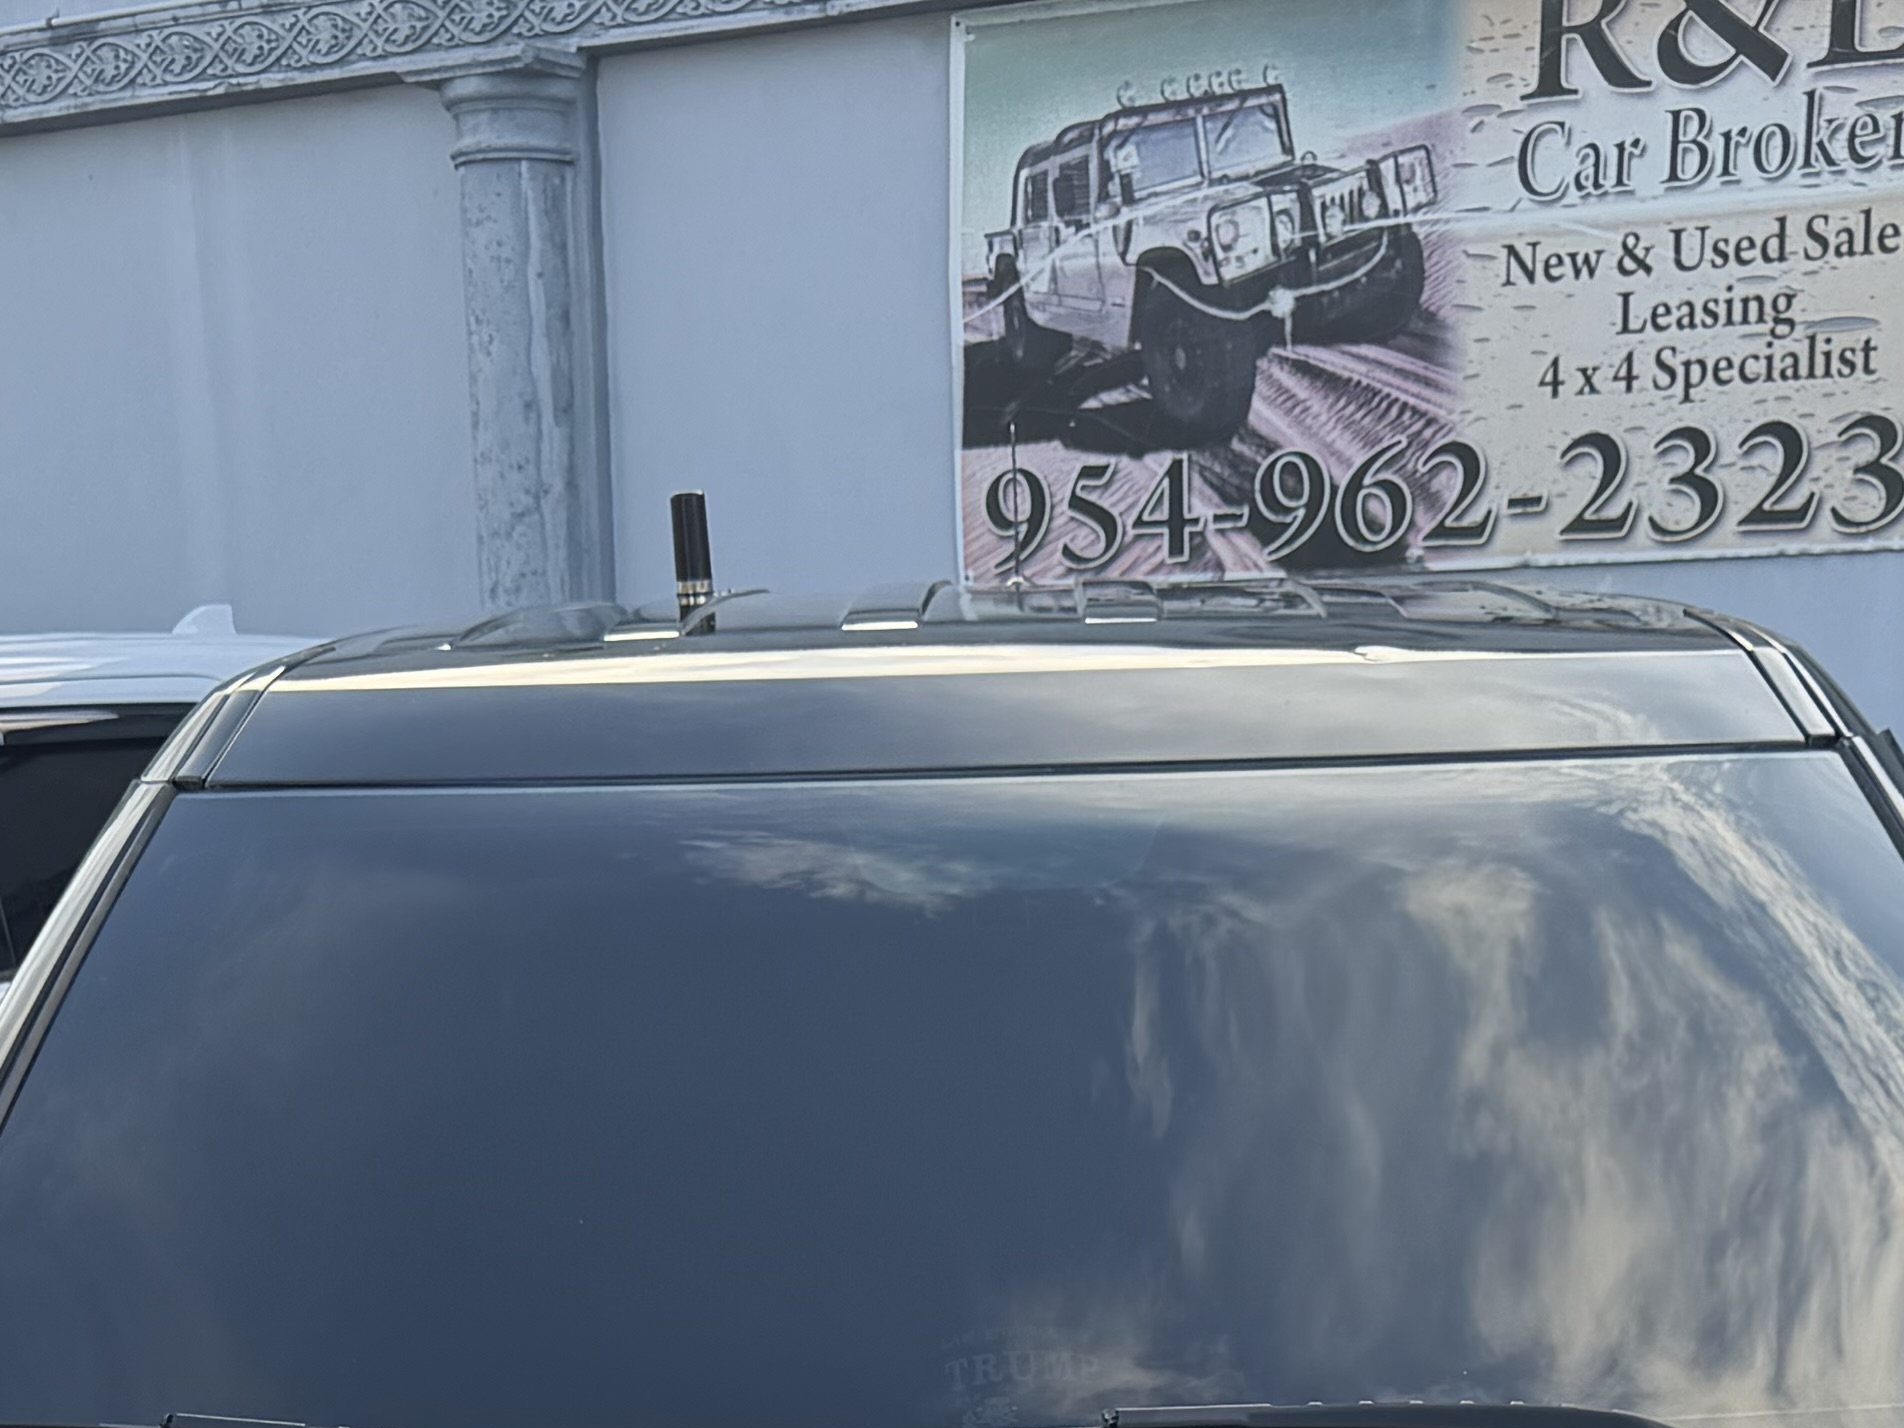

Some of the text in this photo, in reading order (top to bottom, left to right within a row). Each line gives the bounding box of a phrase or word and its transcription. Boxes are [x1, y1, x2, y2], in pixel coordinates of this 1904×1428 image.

[1516, 119, 1647, 201] Car
[1500, 240, 1606, 287] New
[1616, 231, 1656, 279] &
[1668, 215, 1790, 273] Used
[1615, 284, 1799, 340] Leasing
[1538, 333, 1880, 405] 4 x 4 Specialist
[944, 1349, 1100, 1393] TRUMP
